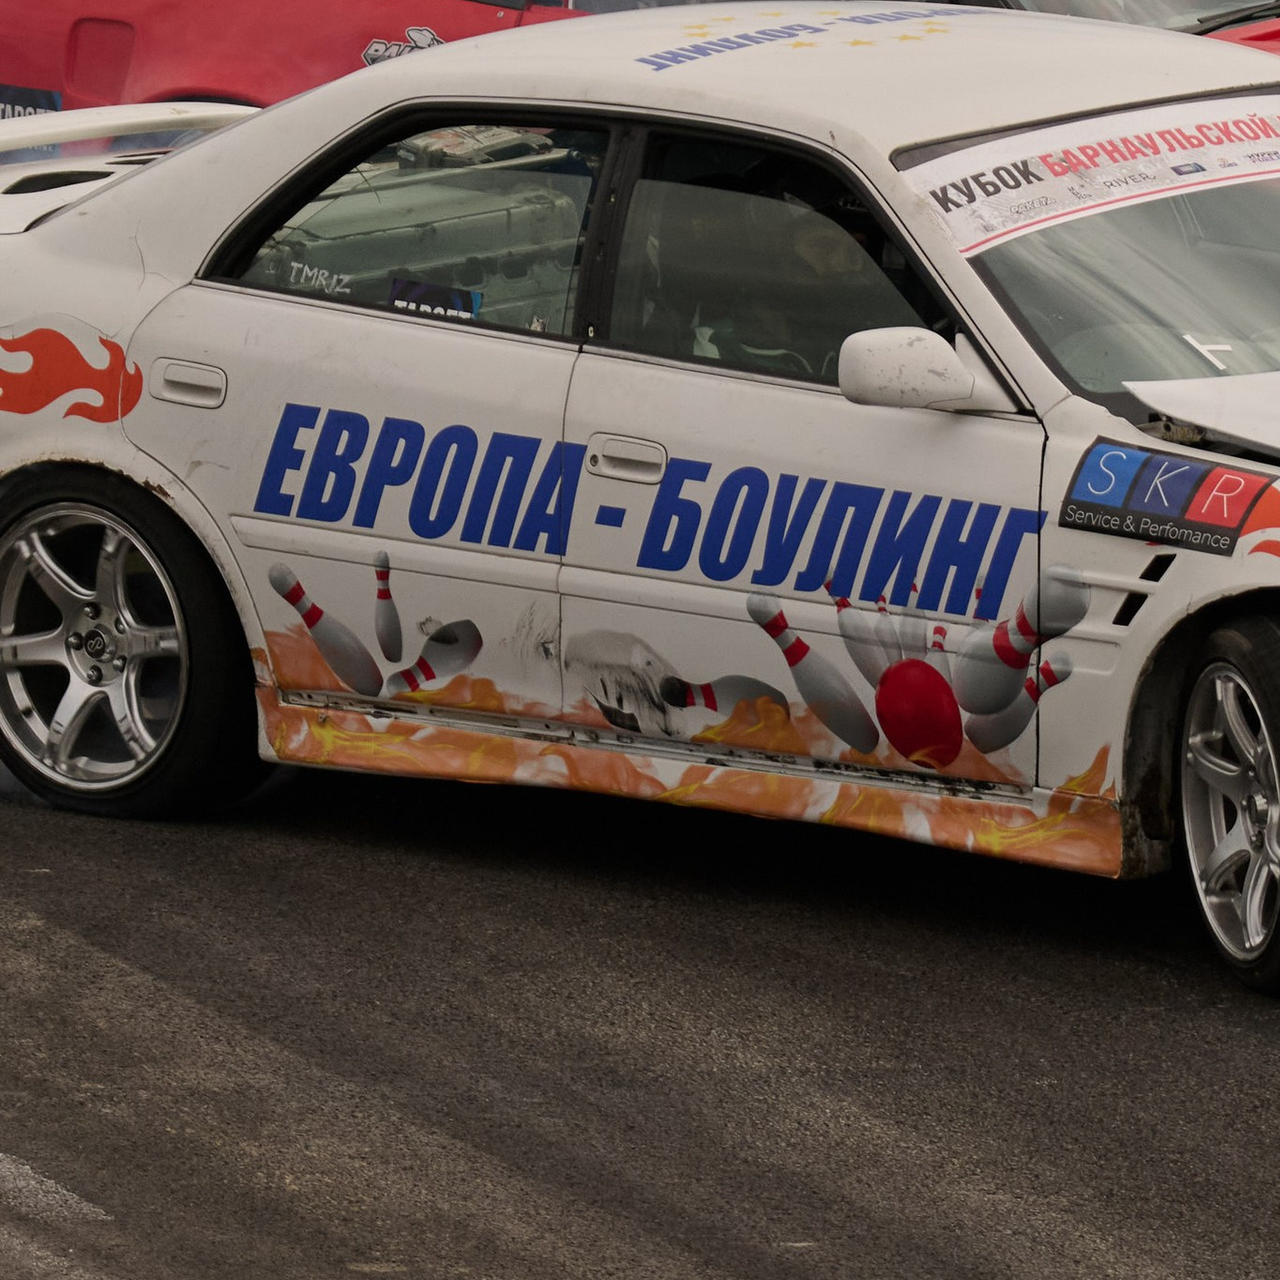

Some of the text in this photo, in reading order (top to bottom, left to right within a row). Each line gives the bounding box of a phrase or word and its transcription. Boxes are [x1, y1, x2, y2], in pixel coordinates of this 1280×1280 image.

[634, 23, 830, 71] БОУЛИНГ
[929, 159, 1044, 213] КУБОК
[1038, 113, 1280, 178] БАРНАУЛЬСКОЙ
[253, 402, 590, 557] ЕВРОПА
[635, 456, 1050, 620] БОУЛИНГ
[1087, 450, 1245, 518] SKR
[1065, 504, 1231, 549] Service & Perfomance
